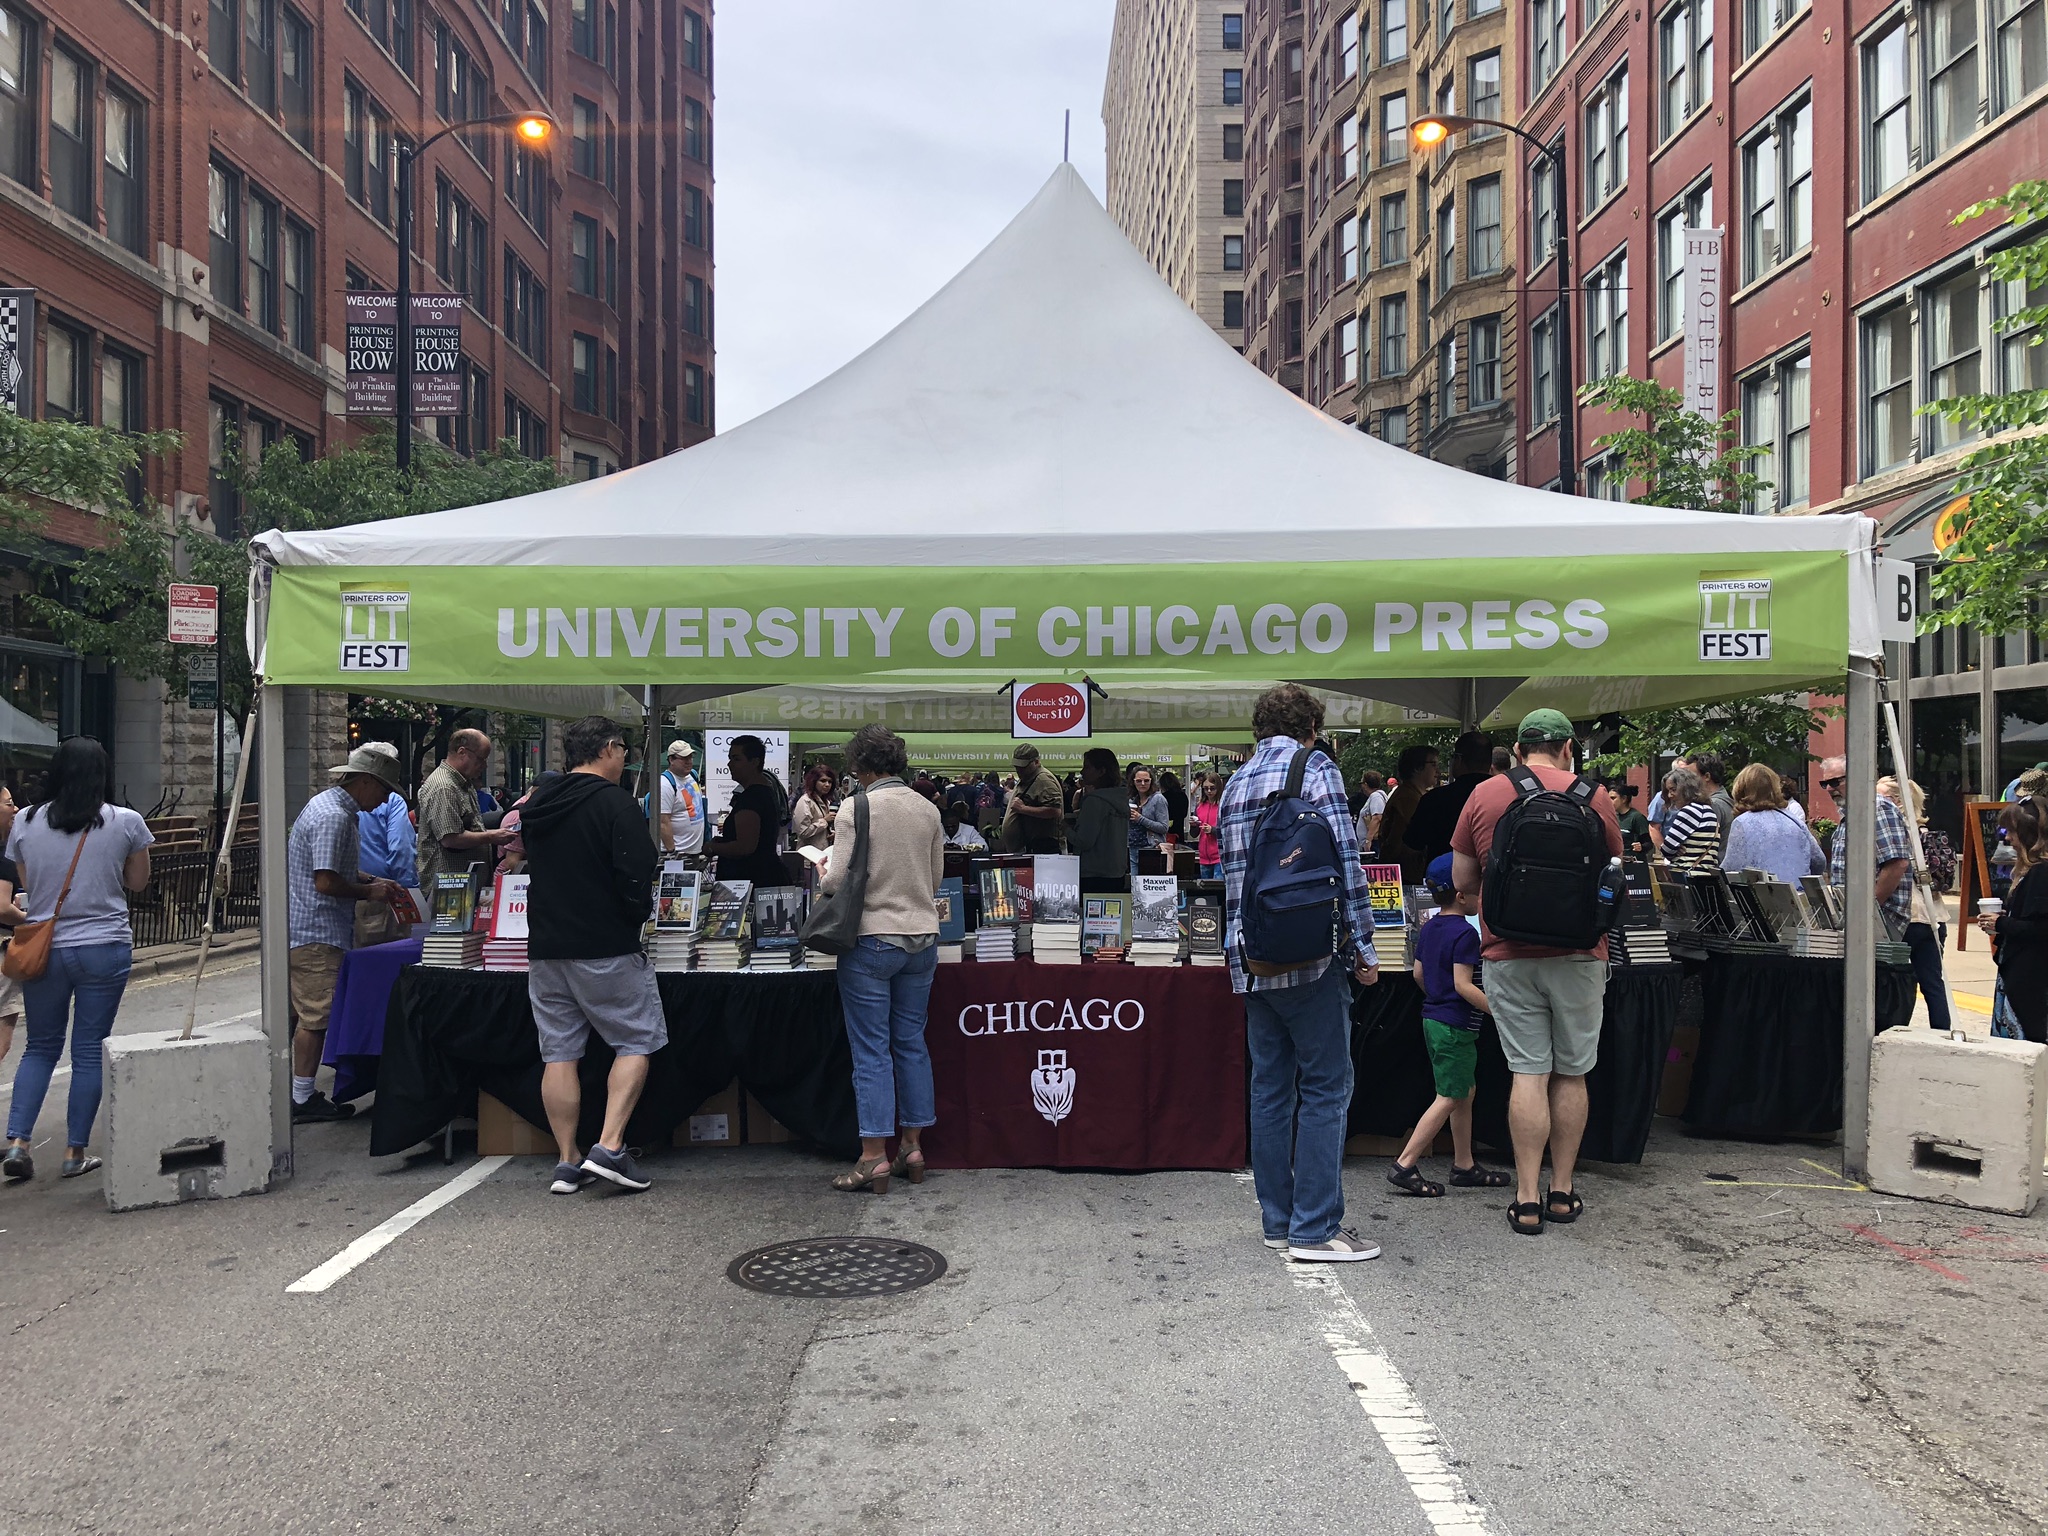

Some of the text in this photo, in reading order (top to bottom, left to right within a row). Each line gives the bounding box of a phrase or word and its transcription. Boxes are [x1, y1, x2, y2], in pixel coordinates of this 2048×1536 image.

[346, 296, 397, 307] WELCOME
[412, 298, 461, 308] WELCOME
[365, 311, 377, 319] TO
[431, 312, 443, 320] TO
[1699, 267, 1716, 370] HOTEL
[349, 326, 394, 336] PRINTING
[415, 328, 459, 336] PRINTING
[350, 336, 394, 349] HOUSE
[415, 338, 459, 350] HOUSE
[350, 351, 394, 370] ROW
[415, 352, 459, 371] ROW
[2, 350, 10, 392] SOUTH LOOP
[347, 382, 395, 391] Old Franklin
[413, 382, 461, 391] Old Franklin
[355, 392, 387, 402] Building
[421, 393, 452, 402] Building
[1897, 574, 1913, 622] B
[1703, 592, 1769, 628] LIT
[345, 605, 407, 640] LIT
[496, 598, 1609, 659] UNIVERSITY OF CHICAGO PRESS
[1702, 633, 1768, 657] FEST
[343, 644, 407, 668] FEST
[1020, 695, 1078, 706] Hardback $20
[1027, 708, 1071, 721] Paper $10
[713, 736, 784, 747] COAL
[993, 752, 1009, 760] MA
[1069, 752, 1083, 760] AN
[773, 892, 794, 900] WATERS
[1035, 883, 1078, 899] CHICAGO
[508, 902, 528, 913] 10
[958, 998, 1145, 1037] CHICAGO
